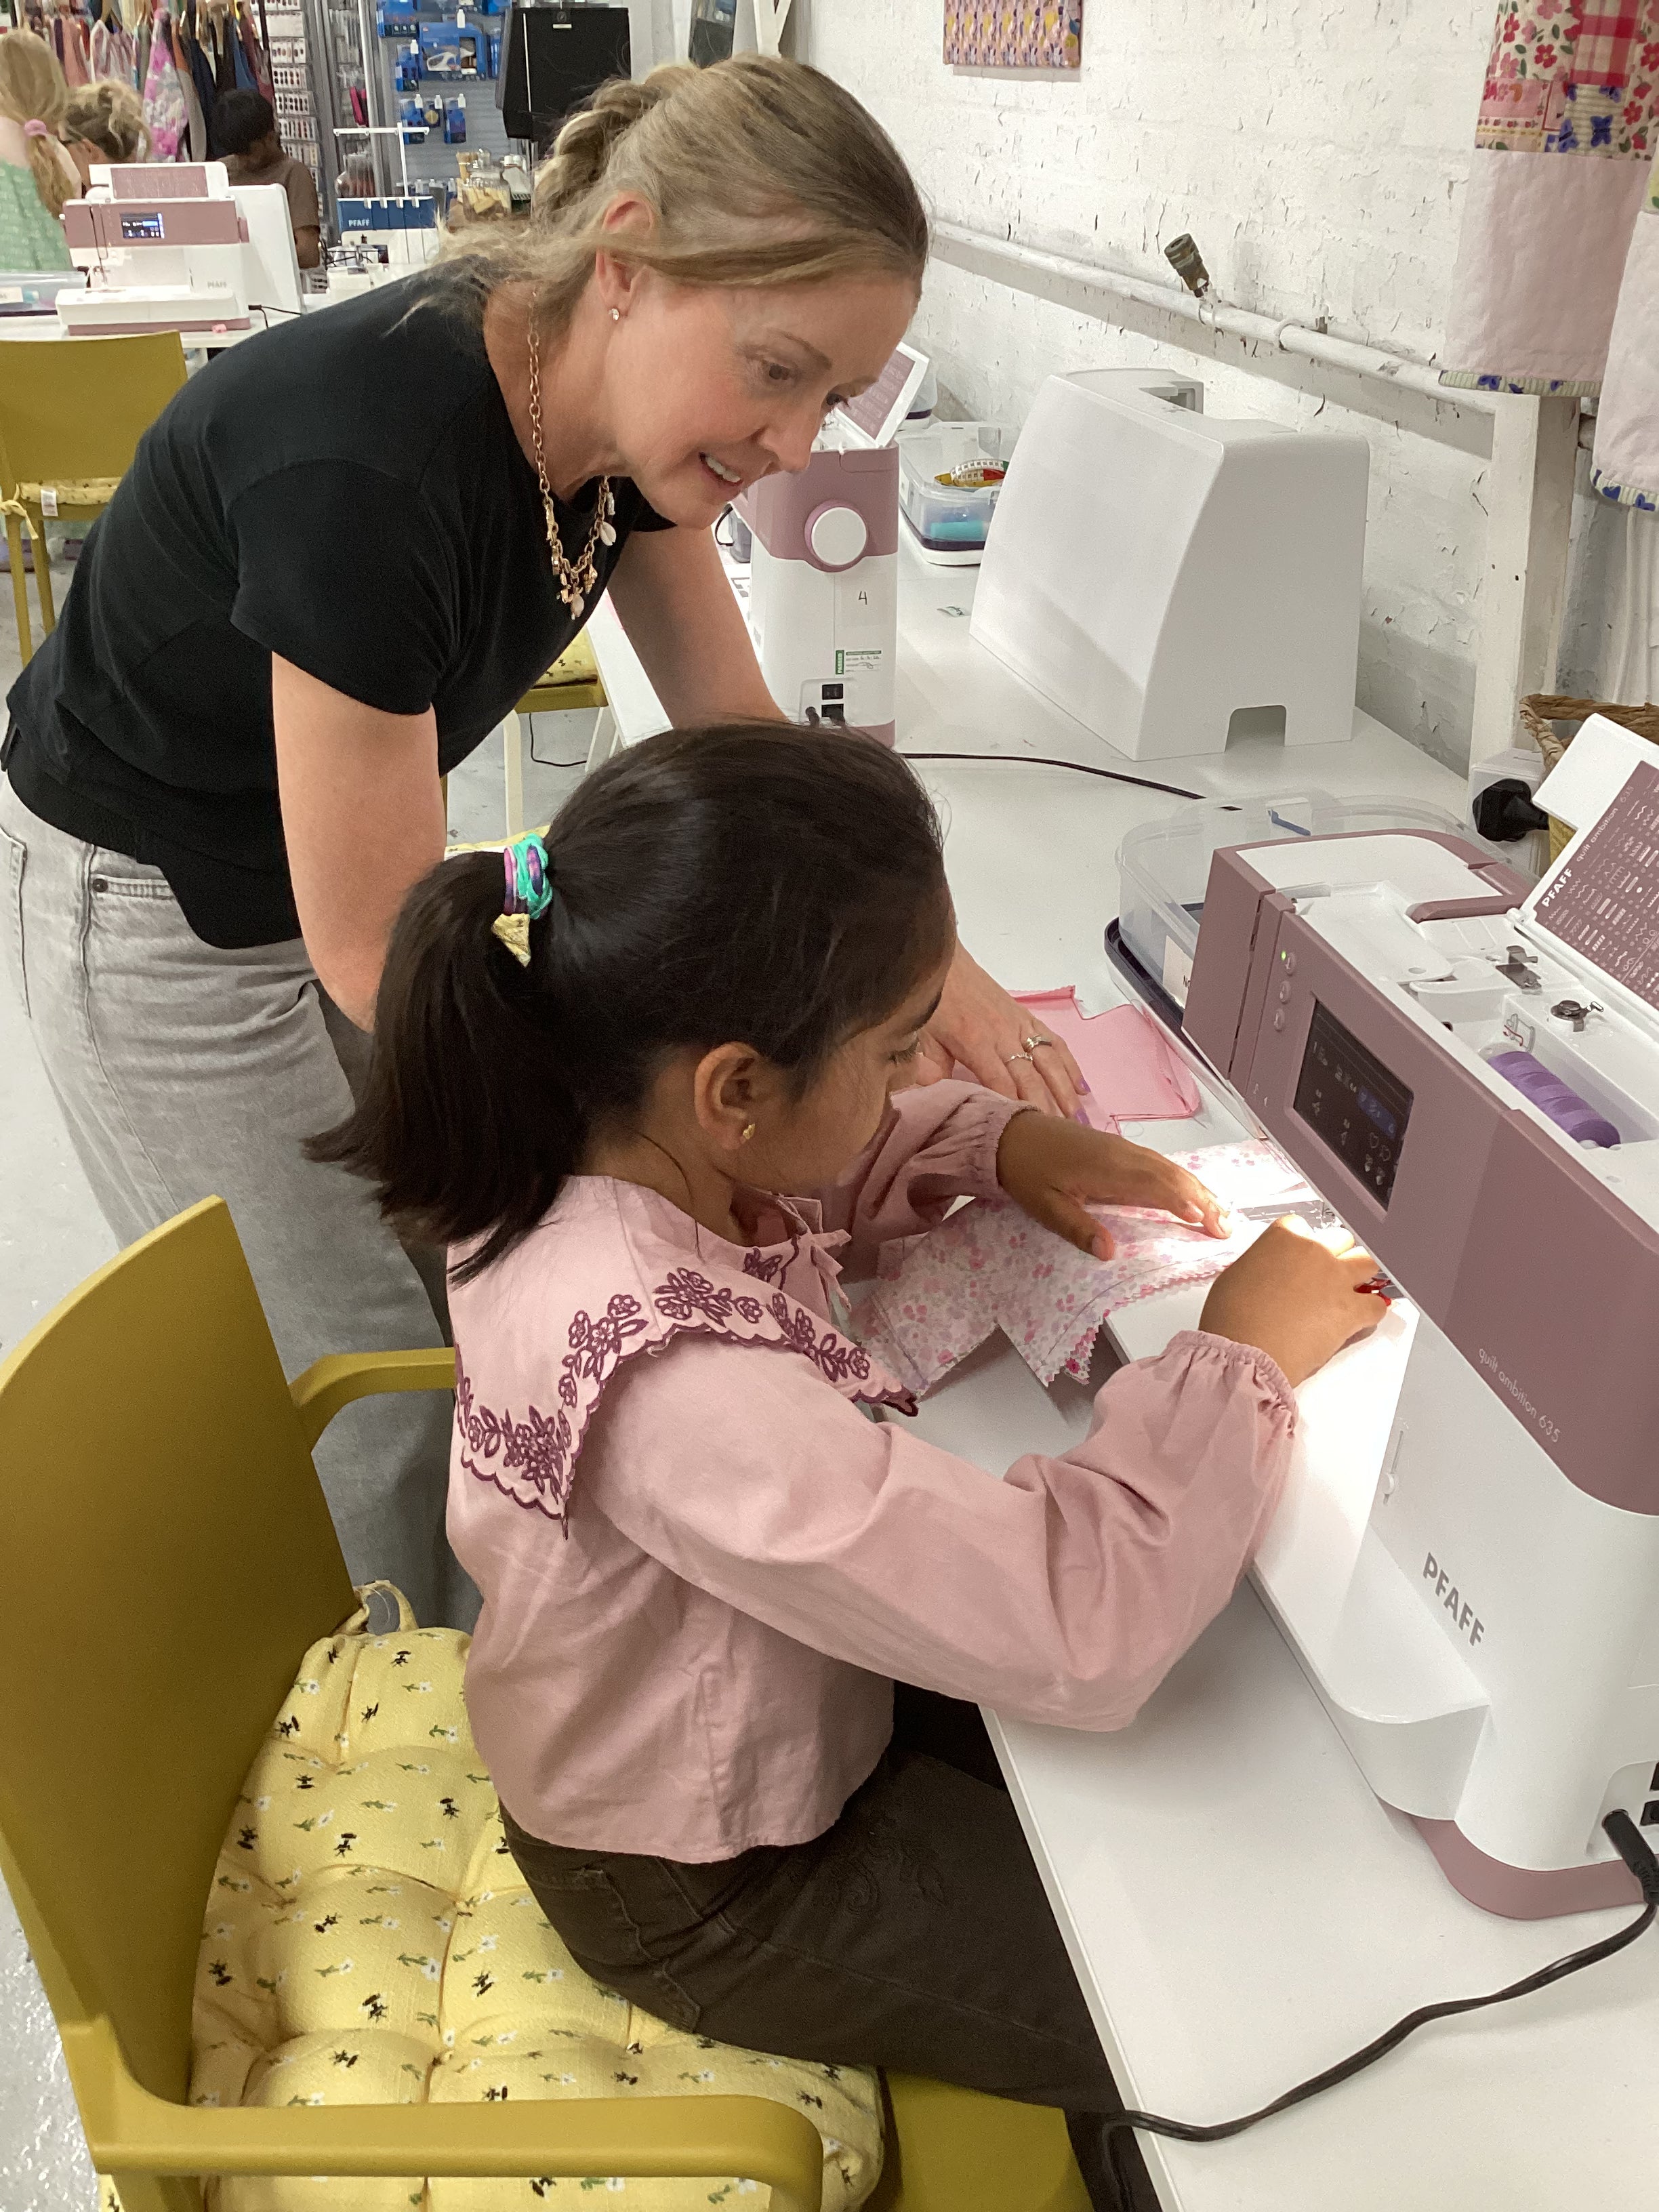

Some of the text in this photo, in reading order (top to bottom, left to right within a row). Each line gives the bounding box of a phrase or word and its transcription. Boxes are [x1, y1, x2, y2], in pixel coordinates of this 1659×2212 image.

[348, 219, 369, 227] PFAFF
[858, 590, 867, 605] 4
[1541, 868, 1572, 907] PFAFF
[1576, 843, 1591, 862] quilt
[1590, 808, 1619, 843] ambition
[1479, 1348, 1560, 1443] quilt ambition 635
[1422, 1552, 1484, 1646] PFAFF
